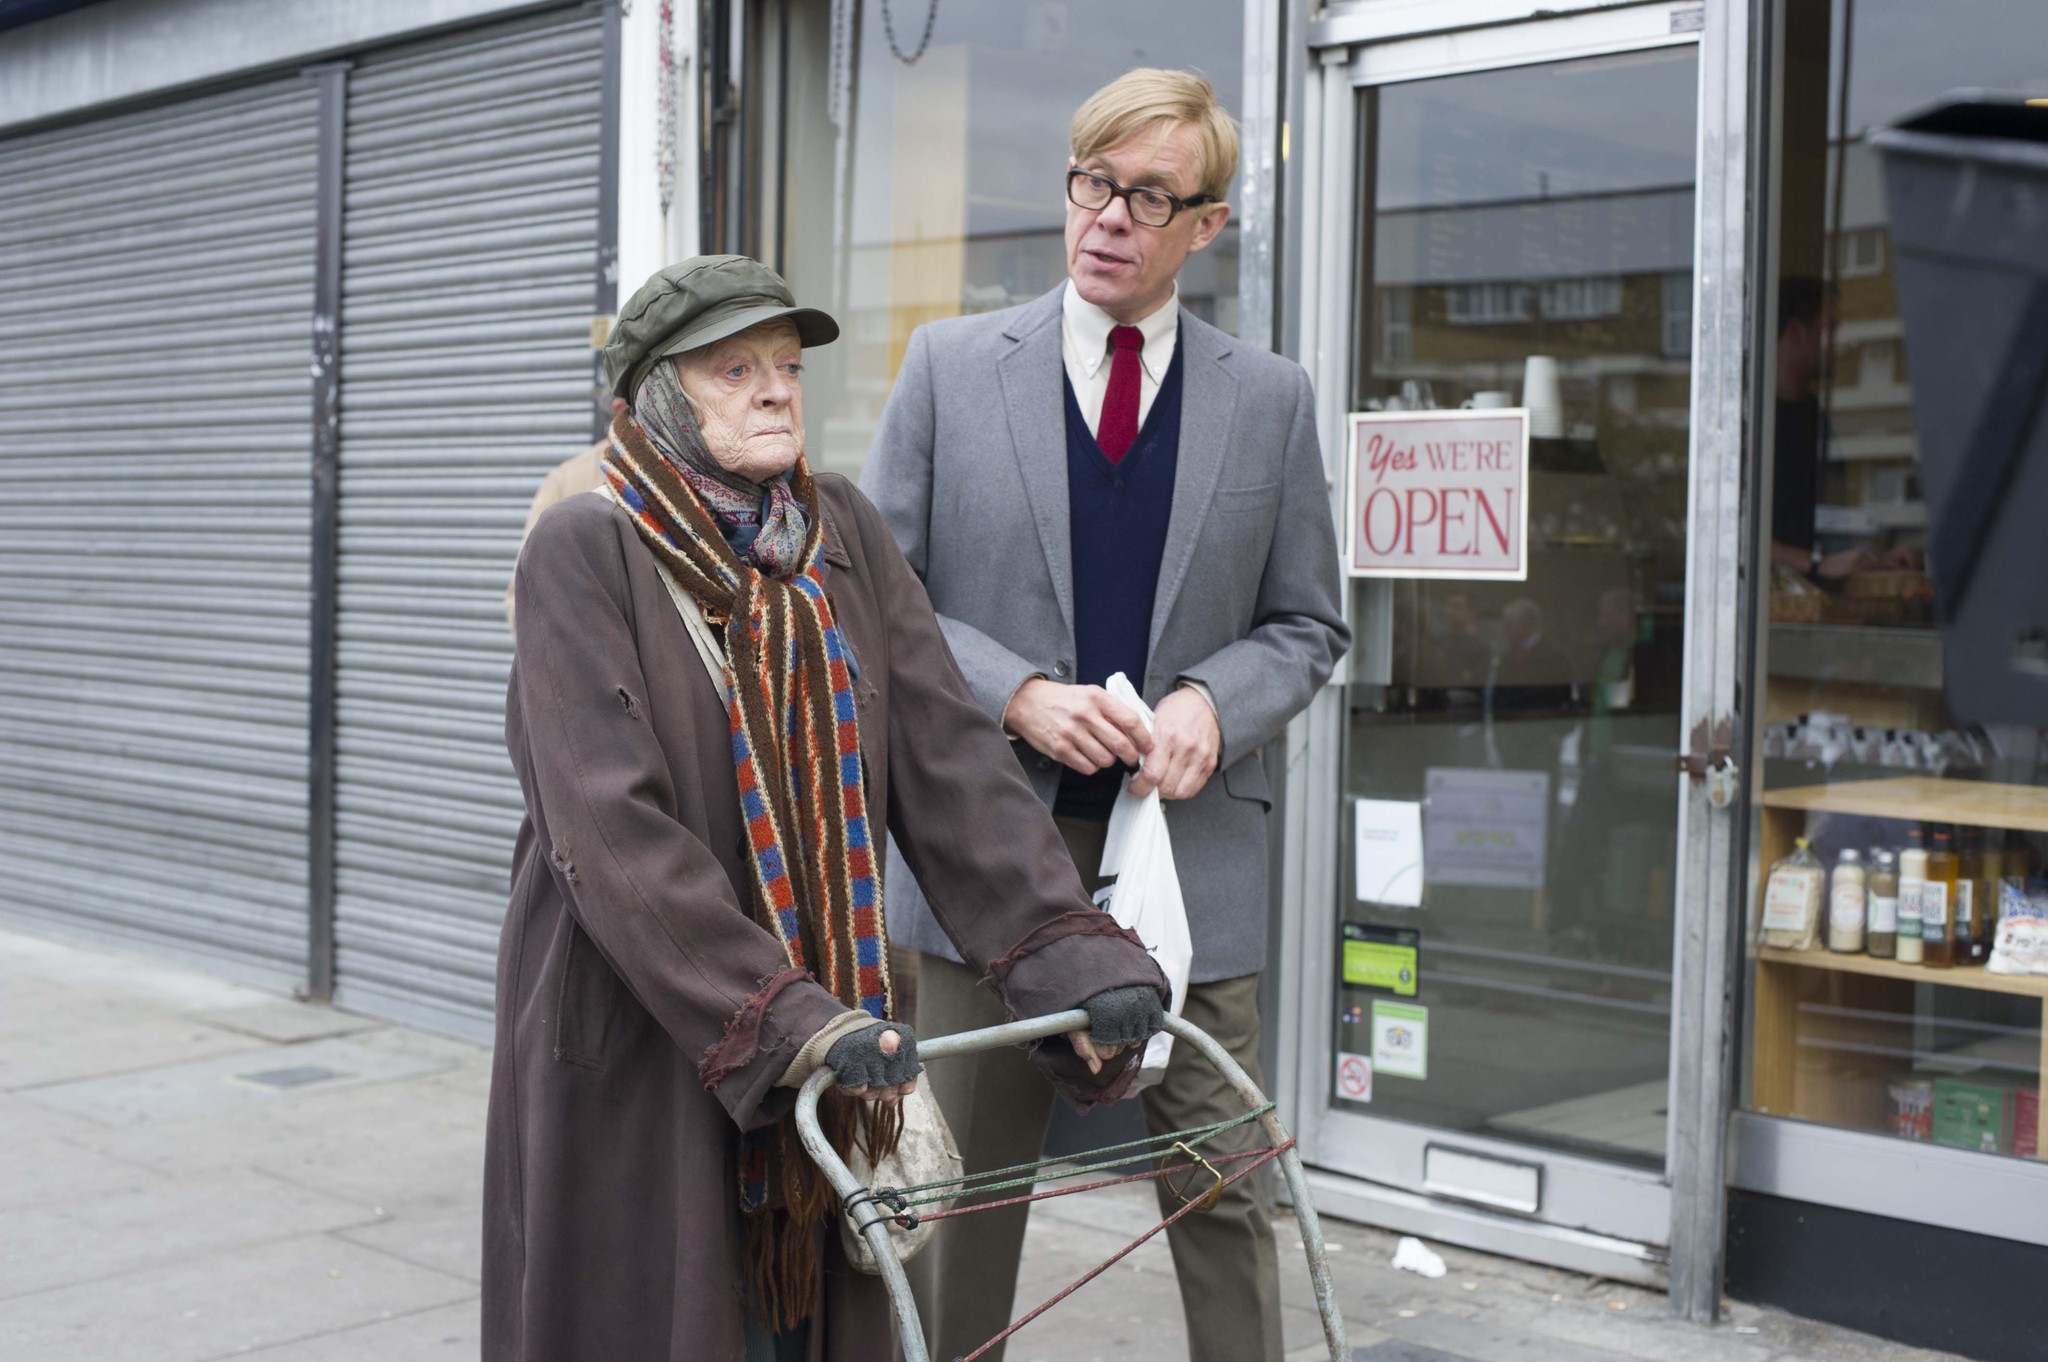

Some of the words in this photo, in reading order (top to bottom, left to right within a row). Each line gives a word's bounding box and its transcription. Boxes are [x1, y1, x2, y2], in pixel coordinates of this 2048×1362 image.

[1367, 433, 1417, 484] Yes
[1425, 440, 1512, 471] WE'RE
[1363, 487, 1513, 556] OPEN
